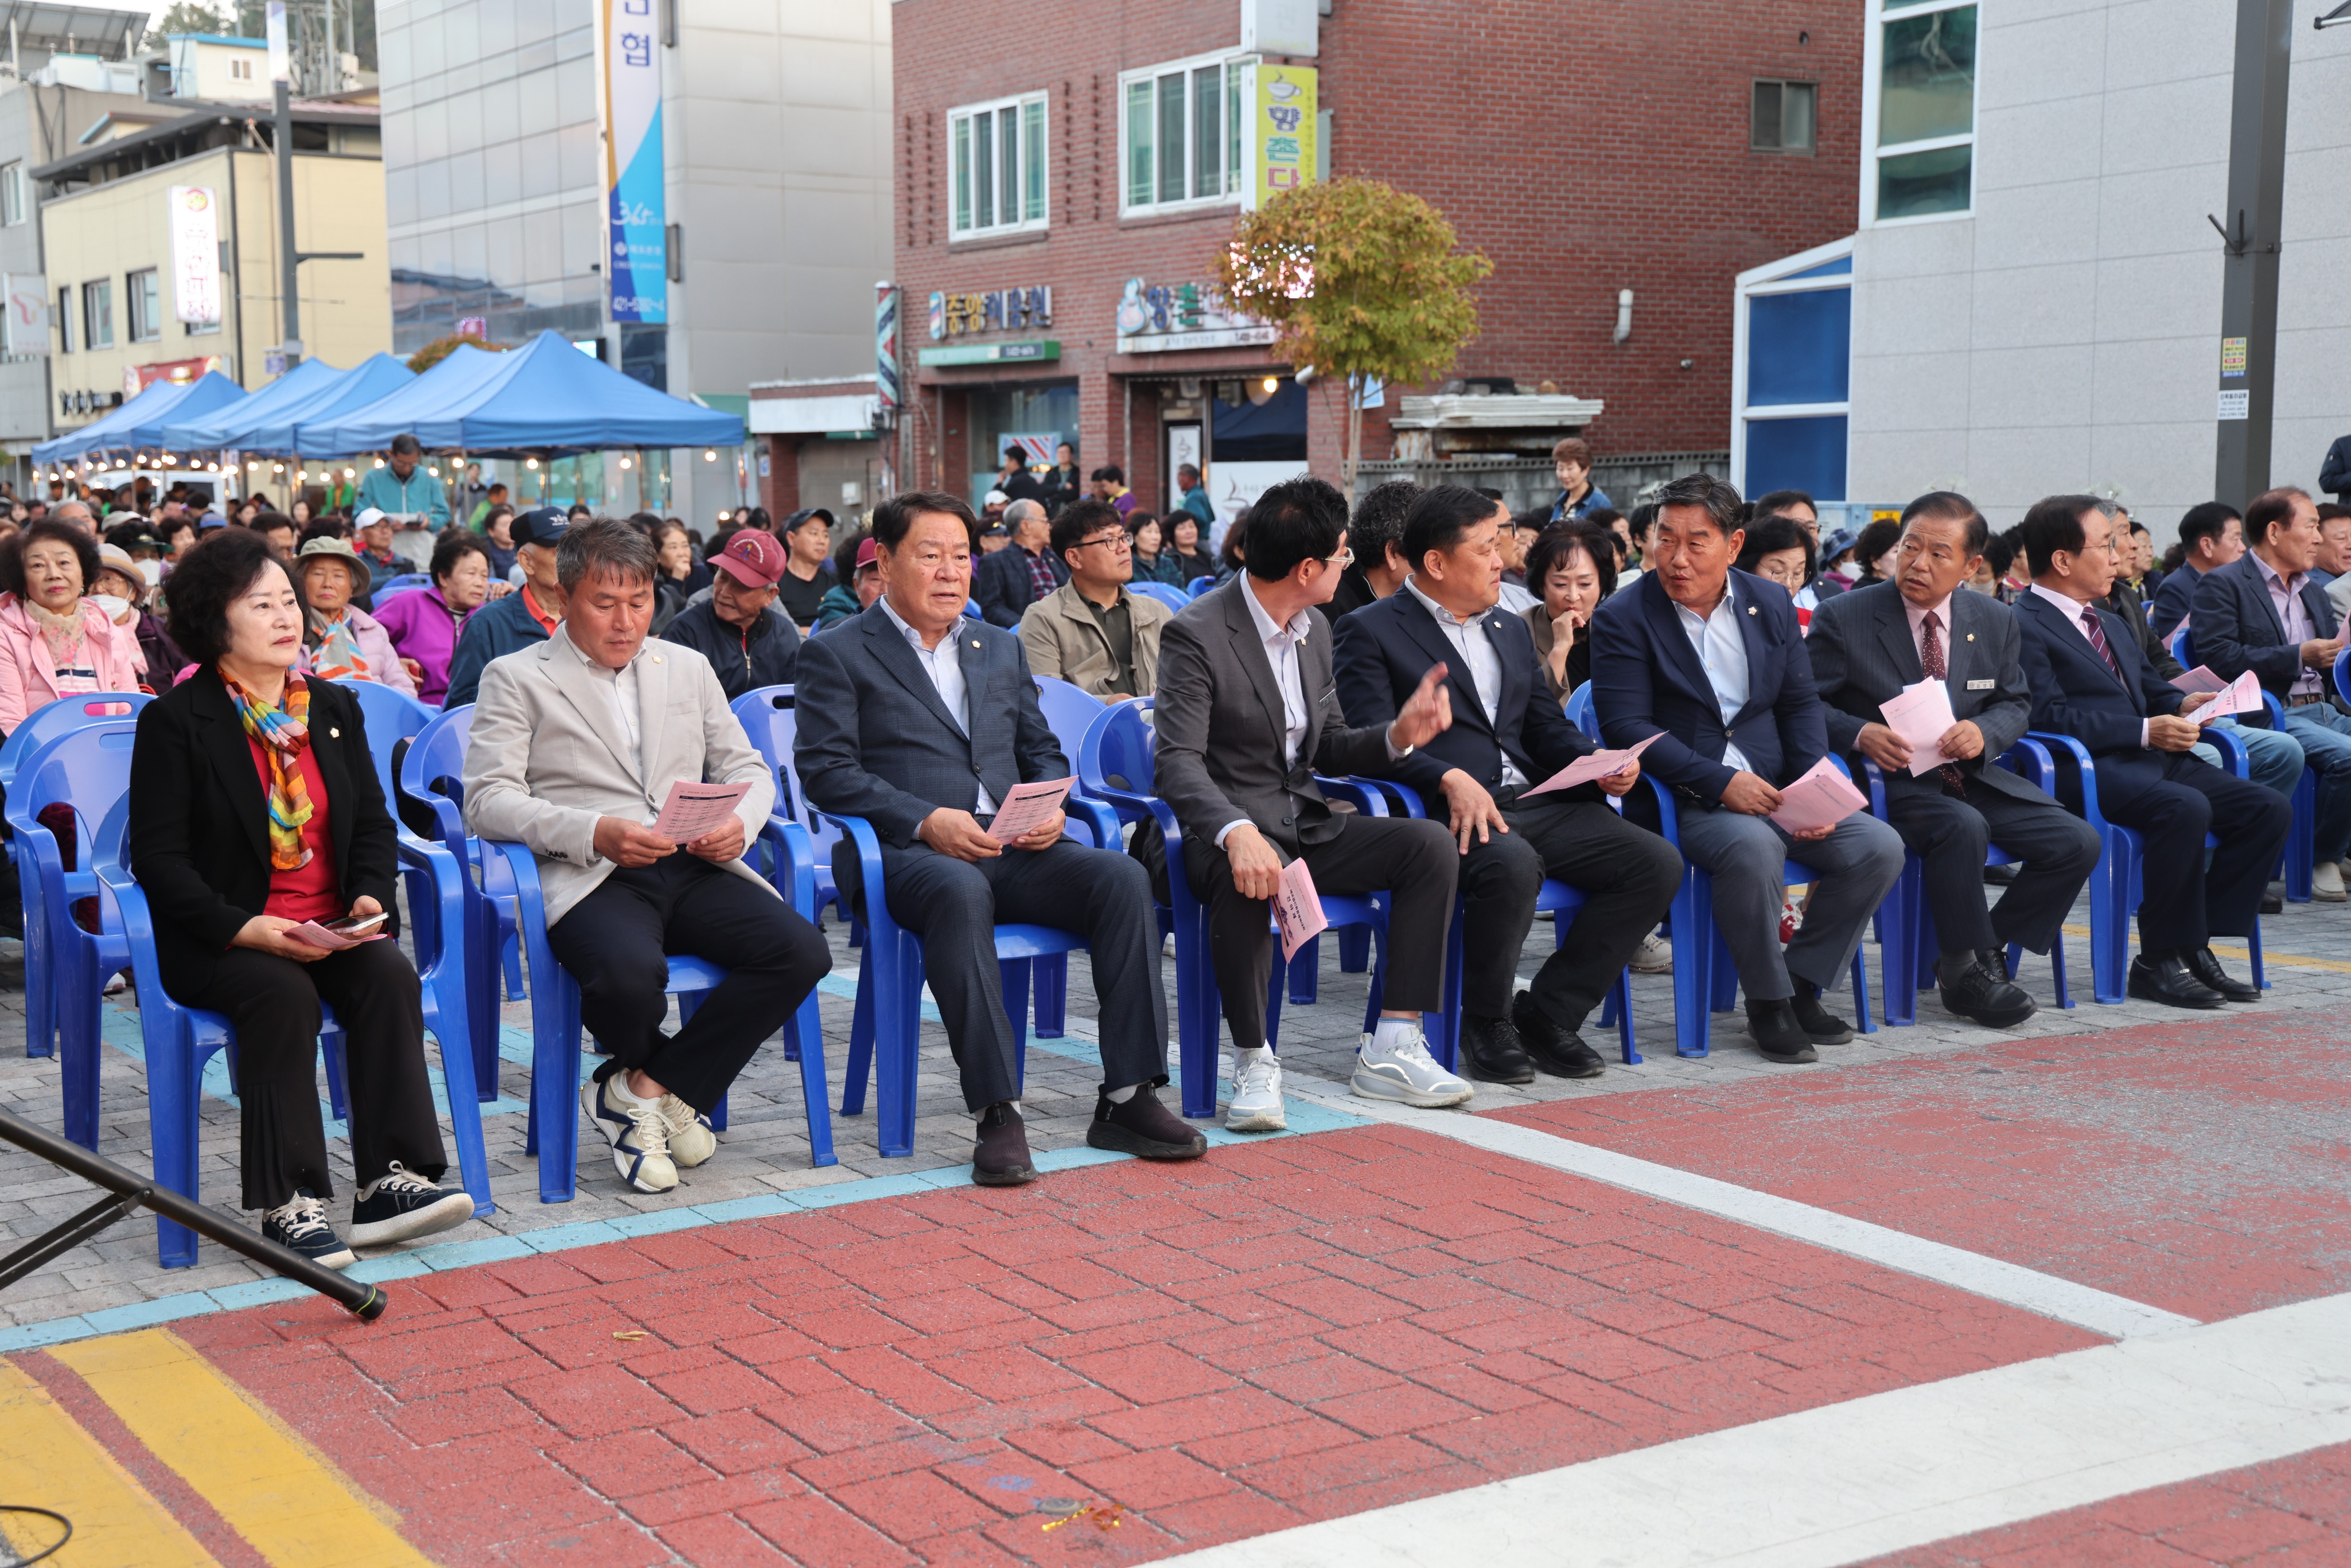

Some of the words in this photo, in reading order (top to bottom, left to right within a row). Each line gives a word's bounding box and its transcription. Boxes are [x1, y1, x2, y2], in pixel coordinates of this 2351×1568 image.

[1266, 106, 1302, 190] 양촌다
[612, 201, 654, 225] 365
[947, 287, 1046, 334] 중앙이용원
